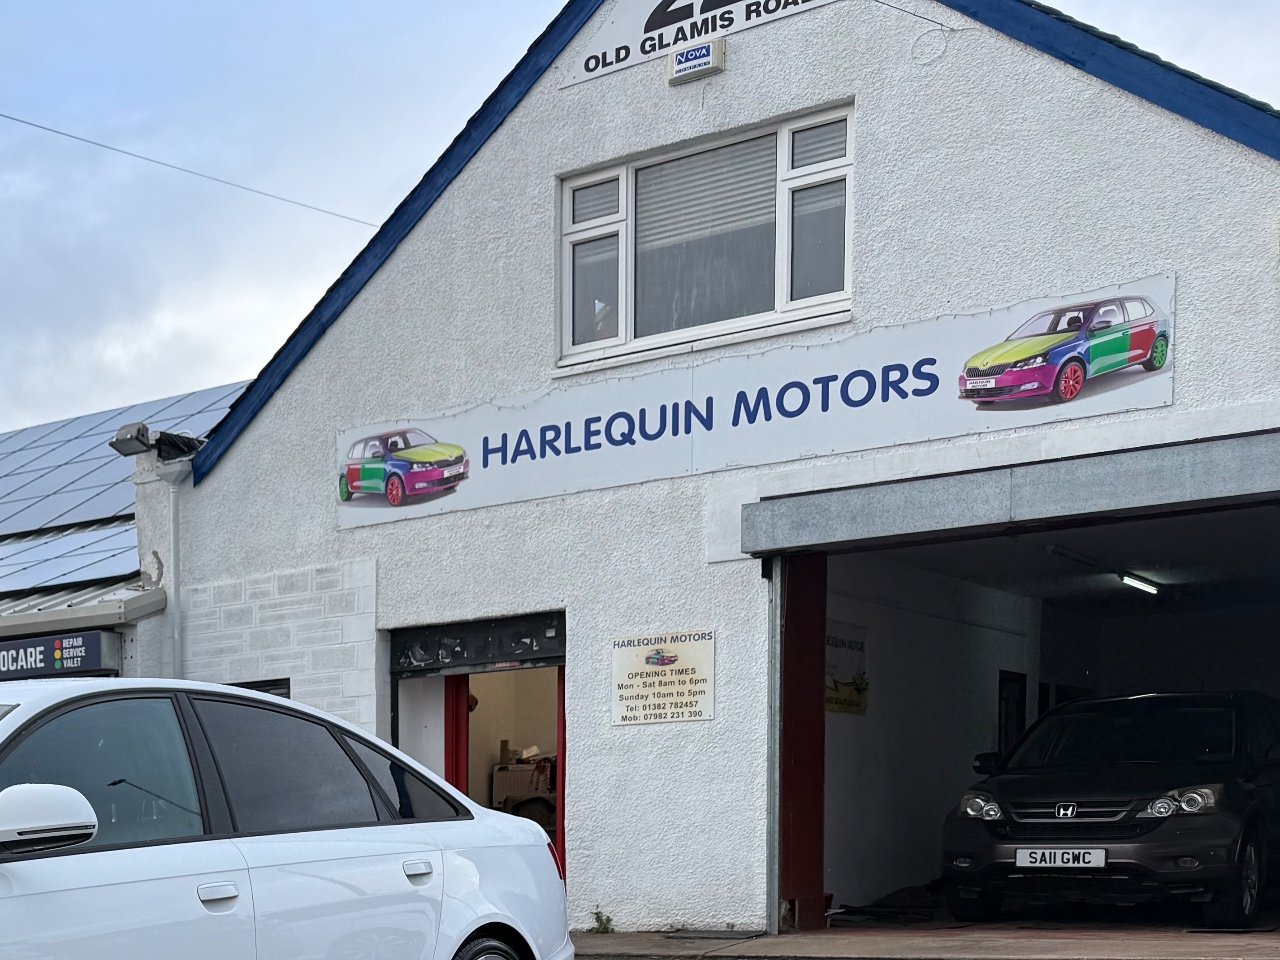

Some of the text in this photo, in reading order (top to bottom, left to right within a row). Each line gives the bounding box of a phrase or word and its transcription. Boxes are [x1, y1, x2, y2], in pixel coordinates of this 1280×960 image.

[584, 45, 631, 74] OLD
[640, 10, 734, 55] GLAMIS
[745, 0, 814, 21] ROA
[676, 48, 708, 65] NOVA
[482, 357, 940, 469] HARLEQUIN MOTORS
[63, 637, 83, 648] REPAIR
[613, 631, 713, 649] HARLEQUIN MOTORS
[63, 647, 86, 658] SERVICE
[63, 658, 81, 668] VALET
[628, 667, 697, 680] OPENING TIMES
[642, 681, 656, 689] Sat
[689, 678, 708, 686] 6pm
[618, 693, 649, 702] Sunday
[652, 691, 674, 699] 10am
[687, 689, 706, 697] 5pm
[625, 700, 699, 713] Tel: 01382 782457
[621, 710, 703, 722] Mob: 07982 231 390
[1061, 851, 1092, 865] GWC
